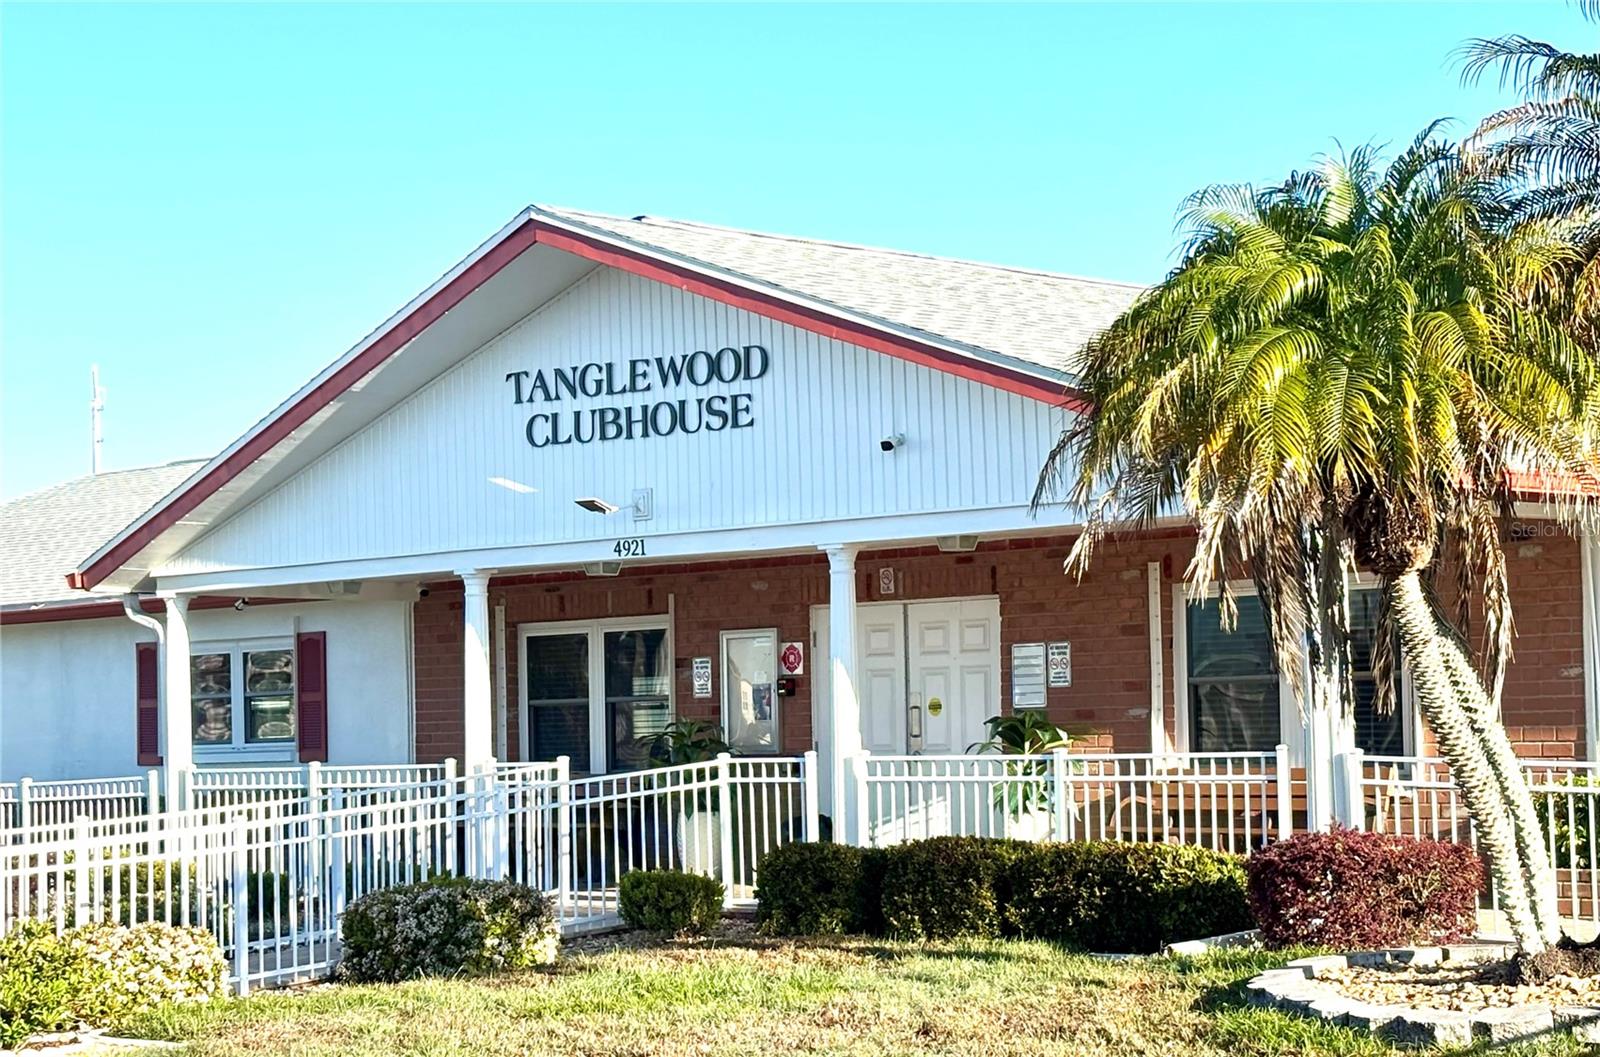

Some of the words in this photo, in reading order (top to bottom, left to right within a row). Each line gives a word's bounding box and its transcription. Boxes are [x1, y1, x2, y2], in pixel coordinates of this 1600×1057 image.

[505, 345, 769, 404] TANGLEWOOD
[525, 393, 755, 448] CLUBHOUSE
[613, 539, 646, 557] 4921
